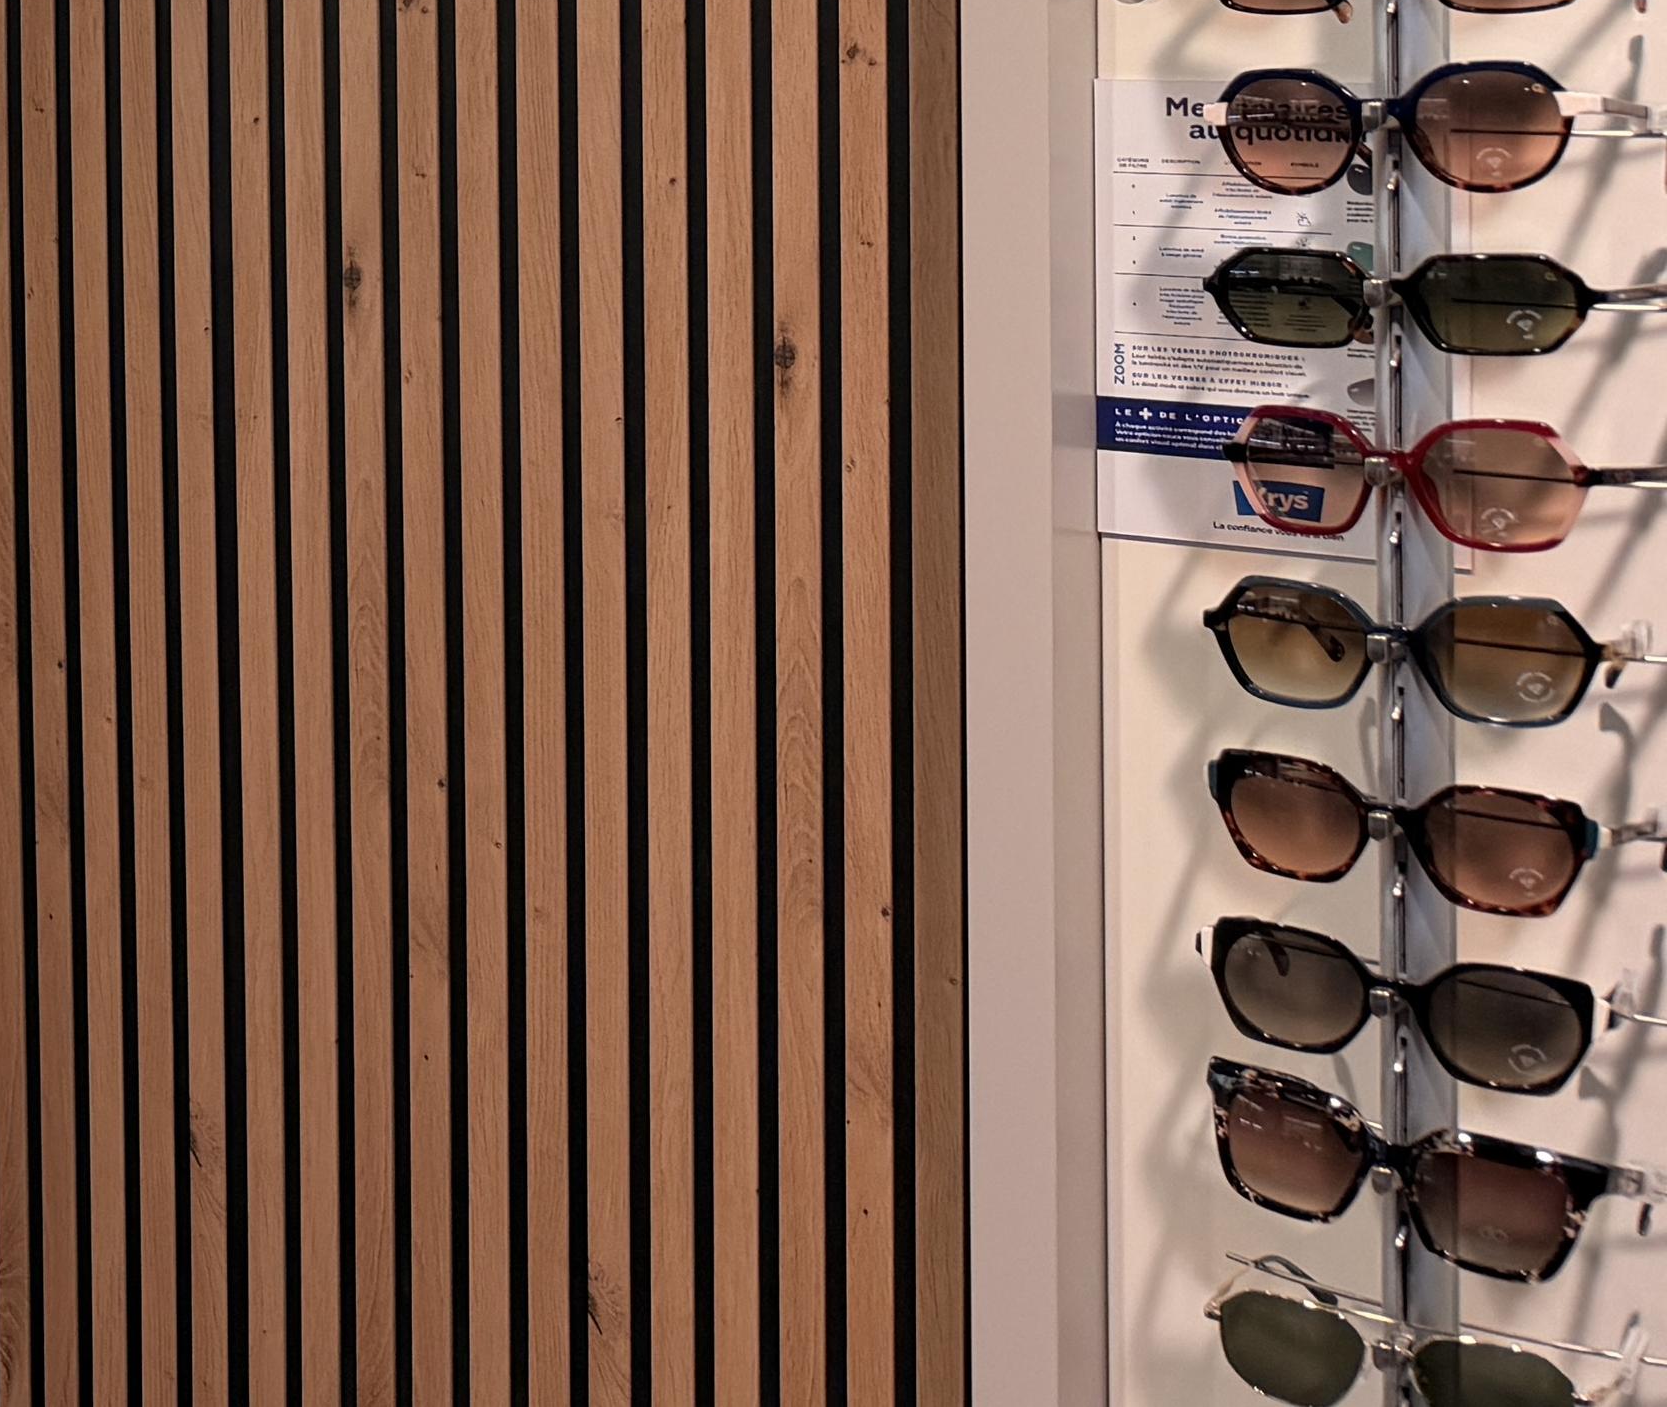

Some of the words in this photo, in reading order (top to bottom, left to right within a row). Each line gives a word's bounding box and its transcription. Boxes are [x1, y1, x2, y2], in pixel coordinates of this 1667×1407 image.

[1114, 343, 1125, 384] ZOOM
[1115, 408, 1132, 416] LE
[1159, 411, 1177, 419] DE
[1213, 521, 1225, 529] La
[1227, 524, 1273, 534] confiance
